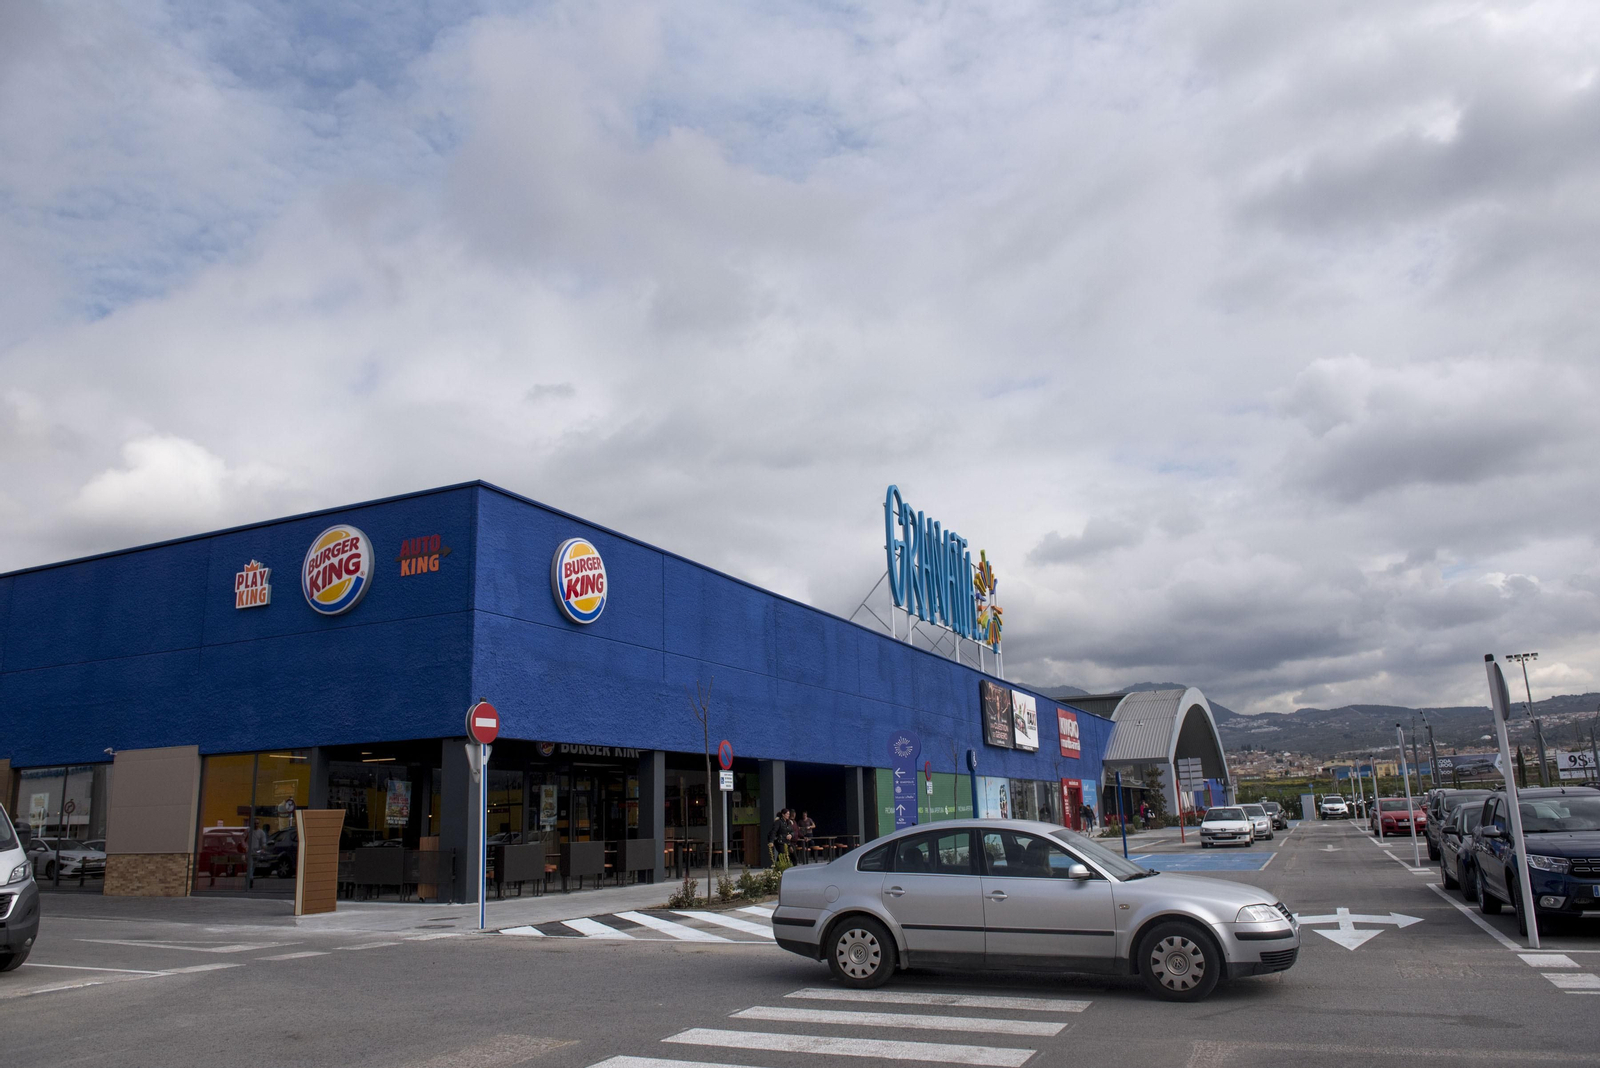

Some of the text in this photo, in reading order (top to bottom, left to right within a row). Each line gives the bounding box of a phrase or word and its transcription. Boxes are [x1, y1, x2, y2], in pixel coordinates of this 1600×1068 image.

[308, 537, 360, 576] BURGER
[401, 534, 440, 556] AUTO
[309, 553, 362, 600] KING
[401, 554, 440, 577] KING
[564, 556, 603, 579] BURGER
[237, 570, 266, 589] PLAY
[565, 573, 604, 601] KING
[237, 587, 266, 607] KING
